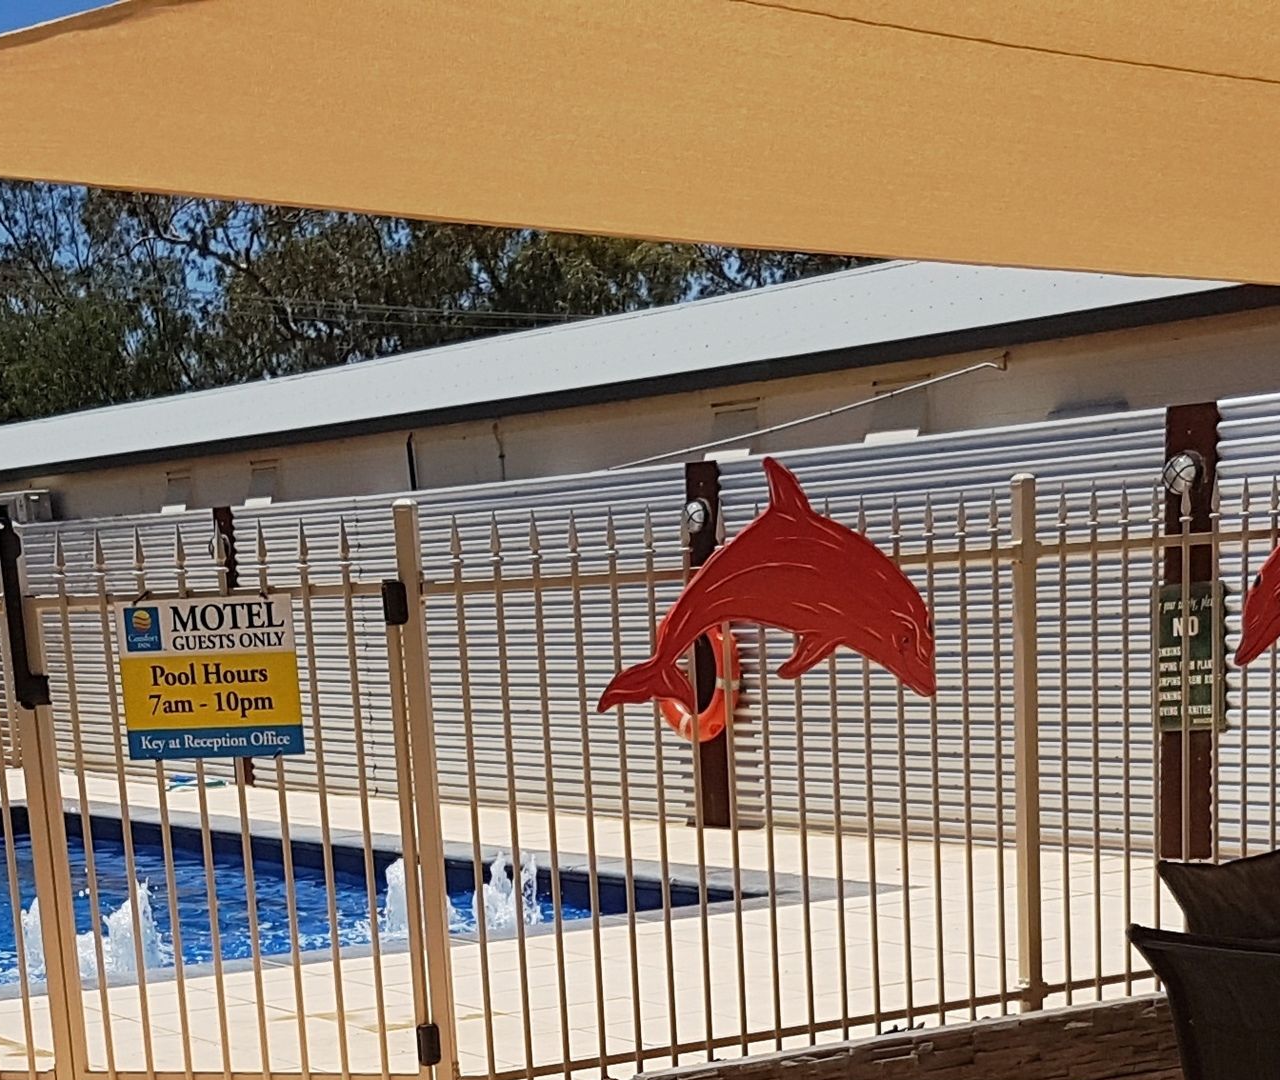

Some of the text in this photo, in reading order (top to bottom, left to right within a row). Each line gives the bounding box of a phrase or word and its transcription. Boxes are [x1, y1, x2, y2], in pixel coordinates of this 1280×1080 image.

[170, 601, 284, 632] MOTEL
[1173, 616, 1199, 637] NO
[172, 631, 285, 650] GUESTS ONLY
[150, 663, 268, 686] Pool Hours
[148, 694, 193, 716] 7am
[214, 691, 273, 718] 10pm
[141, 731, 291, 752] Key at Reception Office
